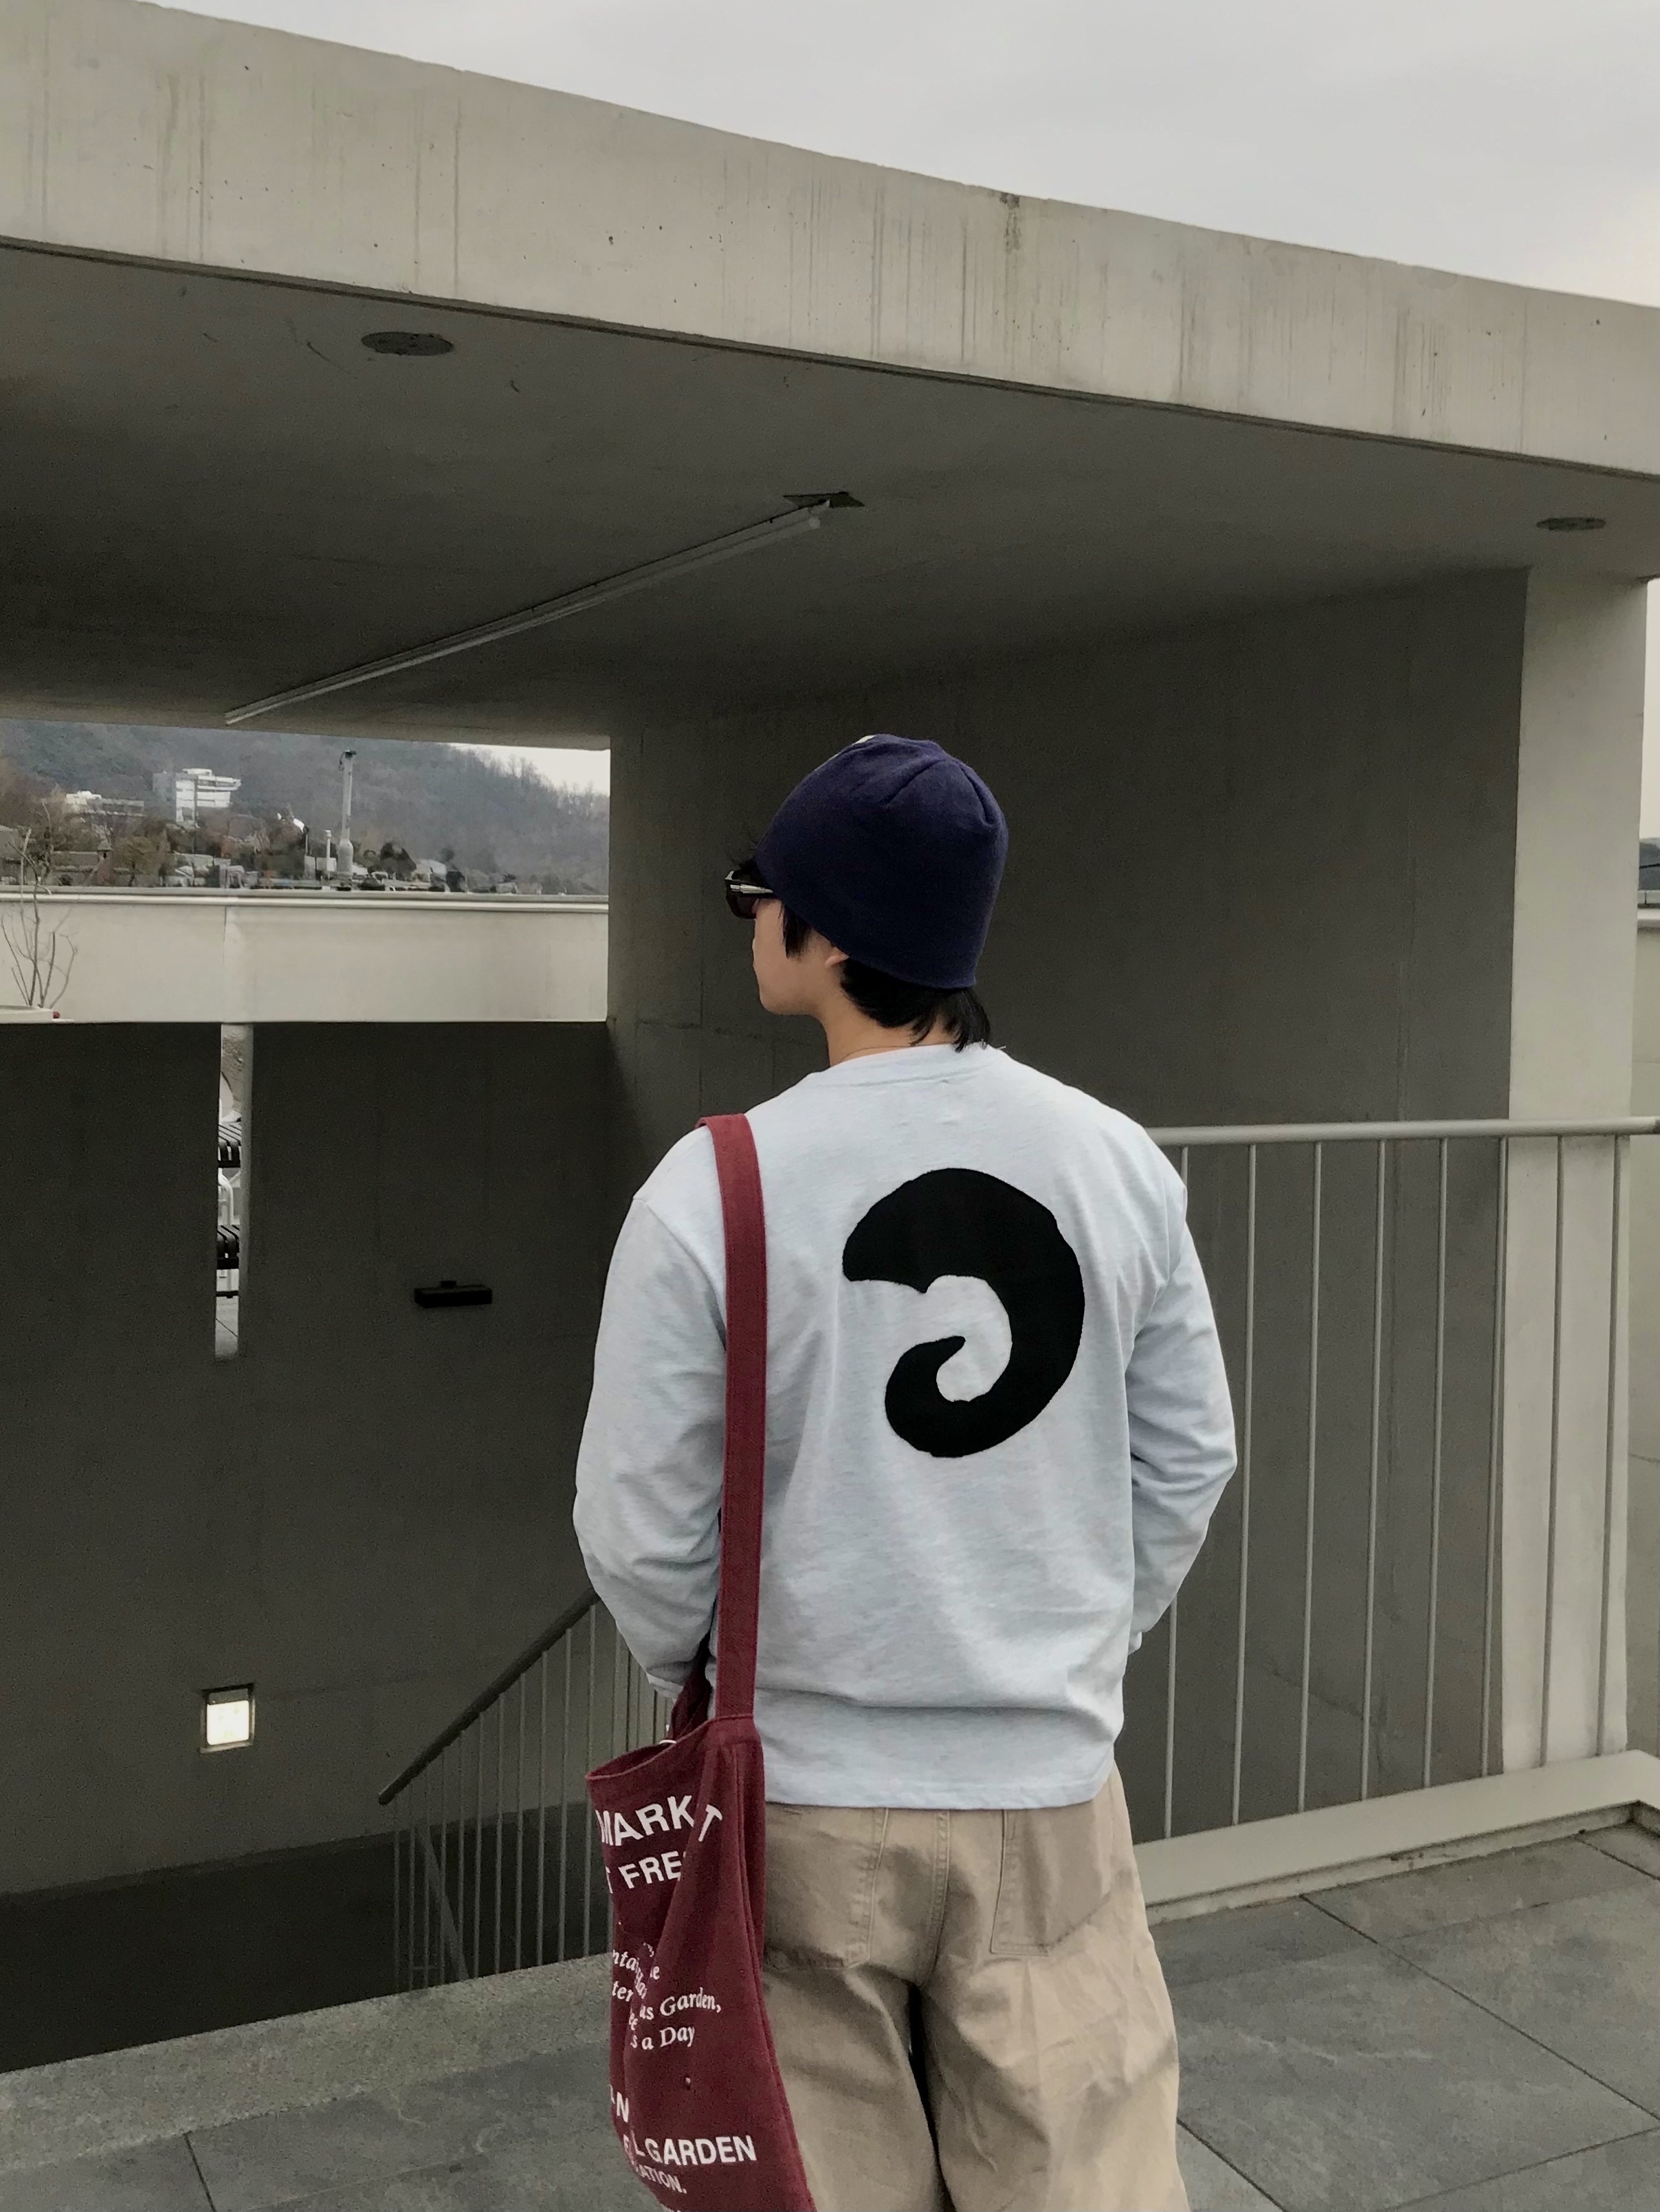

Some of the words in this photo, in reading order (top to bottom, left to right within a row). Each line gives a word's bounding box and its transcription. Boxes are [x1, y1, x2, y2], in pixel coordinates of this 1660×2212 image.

[595, 1795, 723, 1846] MARKT
[660, 1987, 721, 2016] Garden,
[660, 2026, 696, 2048] Day
[645, 2135, 757, 2166] GARDEN
